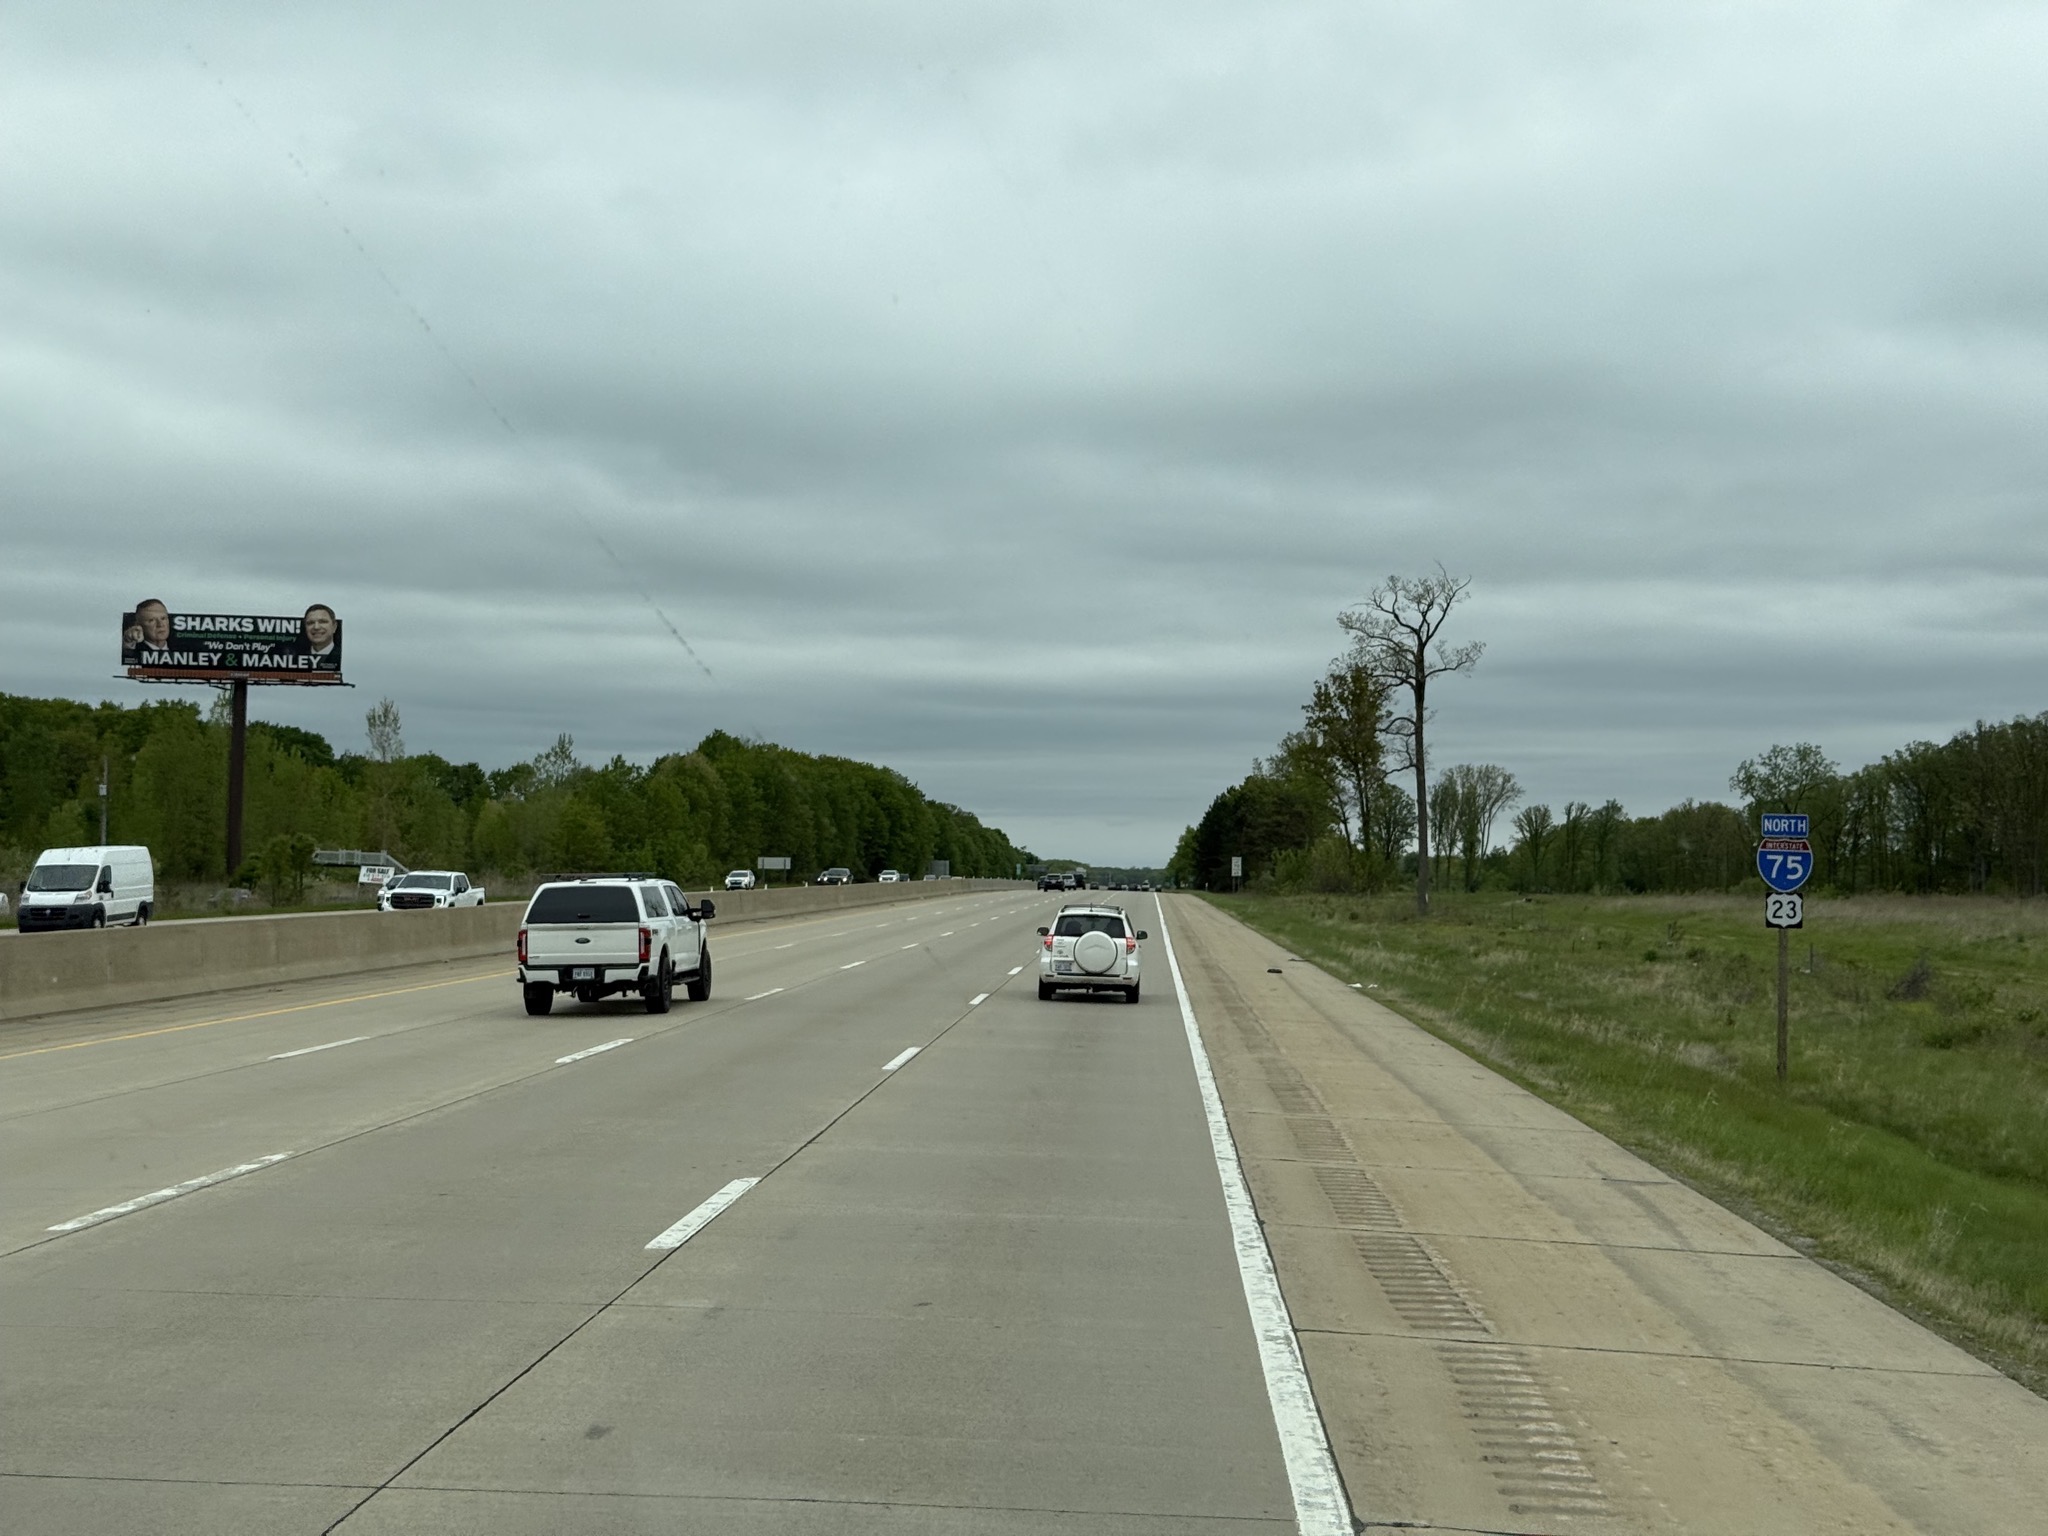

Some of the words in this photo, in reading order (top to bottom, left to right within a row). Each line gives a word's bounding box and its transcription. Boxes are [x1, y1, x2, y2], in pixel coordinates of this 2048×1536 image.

[173, 616, 254, 633] SHARKS
[257, 619, 301, 634] WIN!
[203, 641, 224, 650] "We
[225, 642, 251, 651] Don't
[251, 642, 276, 653] Play"
[276, 635, 297, 643] Injury
[142, 651, 222, 666] MANLEY
[225, 653, 238, 667] &
[242, 653, 322, 669] MANLEY
[1764, 818, 1806, 833] NORTH
[1766, 842, 1804, 850] INTERSTATE
[1766, 854, 1804, 880] 75
[1772, 899, 1797, 919] 23
